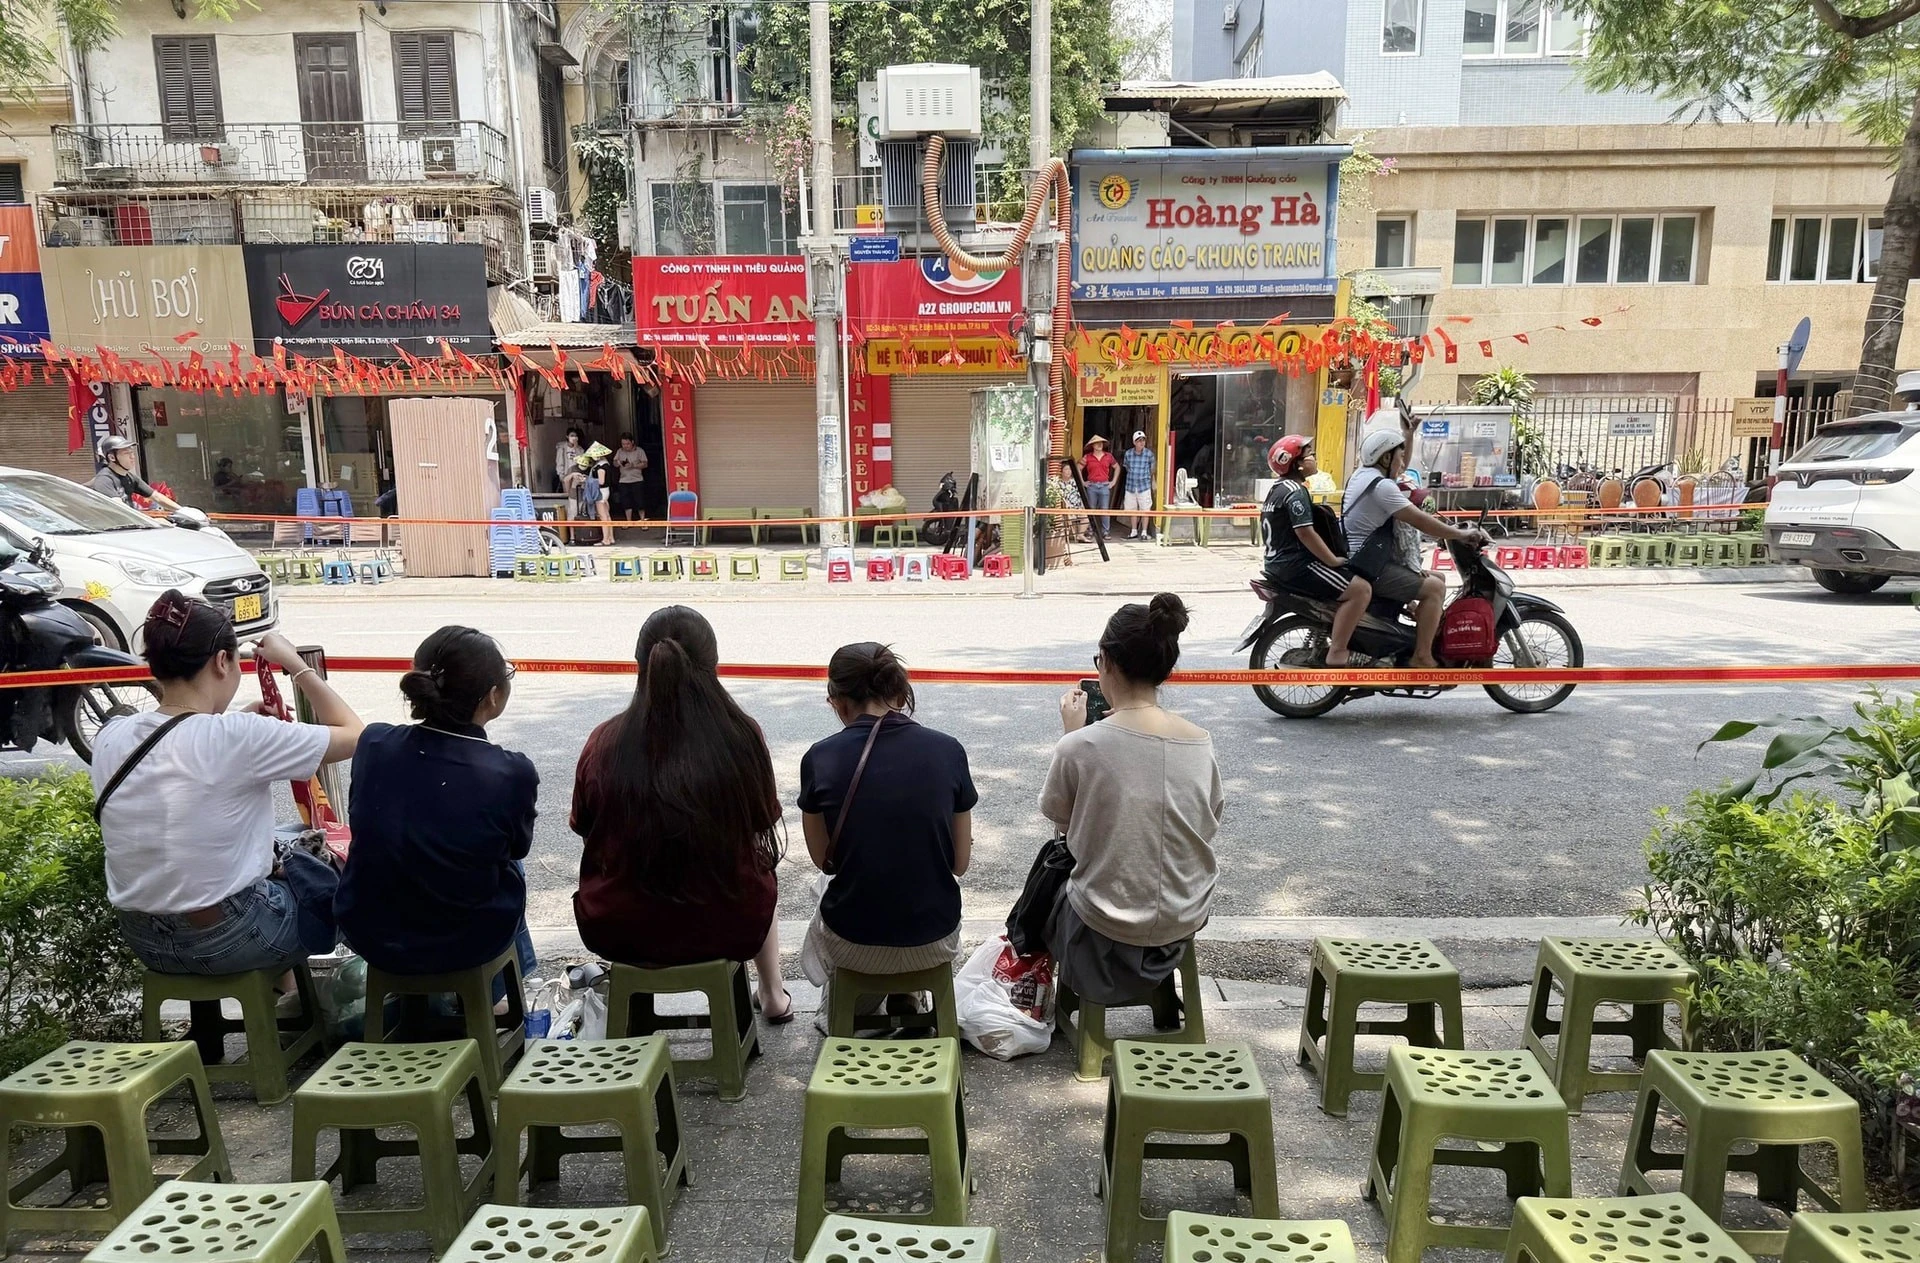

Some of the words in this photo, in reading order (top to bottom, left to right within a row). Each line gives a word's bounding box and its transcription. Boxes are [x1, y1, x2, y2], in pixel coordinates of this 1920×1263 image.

[1181, 176, 1206, 185] Công
[1209, 176, 1218, 186] ty
[1221, 176, 1244, 184] TNHH
[1246, 174, 1276, 185] Quảng
[1279, 174, 1297, 184] cáo
[1145, 195, 1263, 235] Hoàng
[1270, 191, 1321, 226] Hà
[1082, 233, 1146, 272] QUẢNG
[1263, 242, 1322, 268] TRANH
[660, 263, 690, 274] CÔNG
[692, 264, 704, 273] TY
[705, 264, 731, 274] TNHH
[733, 264, 743, 274] IN
[744, 262, 767, 273] THÊU
[769, 261, 805, 274] QUẢNG
[97, 269, 140, 318] HŨ
[1085, 284, 1110, 298] 34
[1111, 286, 1134, 298] Nguyễn
[1136, 287, 1151, 296] Thái
[1152, 287, 1166, 297] Học
[319, 301, 355, 320] BÚN
[358, 301, 383, 320] CÁ
[384, 299, 437, 320] CHẤM
[440, 304, 461, 320] 34
[652, 279, 752, 323] TUẤN
[764, 295, 815, 323] AN
[918, 303, 937, 315] A2Z
[938, 301, 1011, 315] GROUP.COM.VN
[876, 348, 891, 369] HỆ
[1084, 366, 1099, 377] 34
[1080, 373, 1117, 398] Lẩu
[559, 663, 579, 671] QUA
[1330, 672, 1349, 681] QUA
[1356, 672, 1389, 681] POLICE
[1416, 672, 1430, 681] DO
[1432, 672, 1450, 681] NOT
[1453, 672, 1484, 681] CROSS
